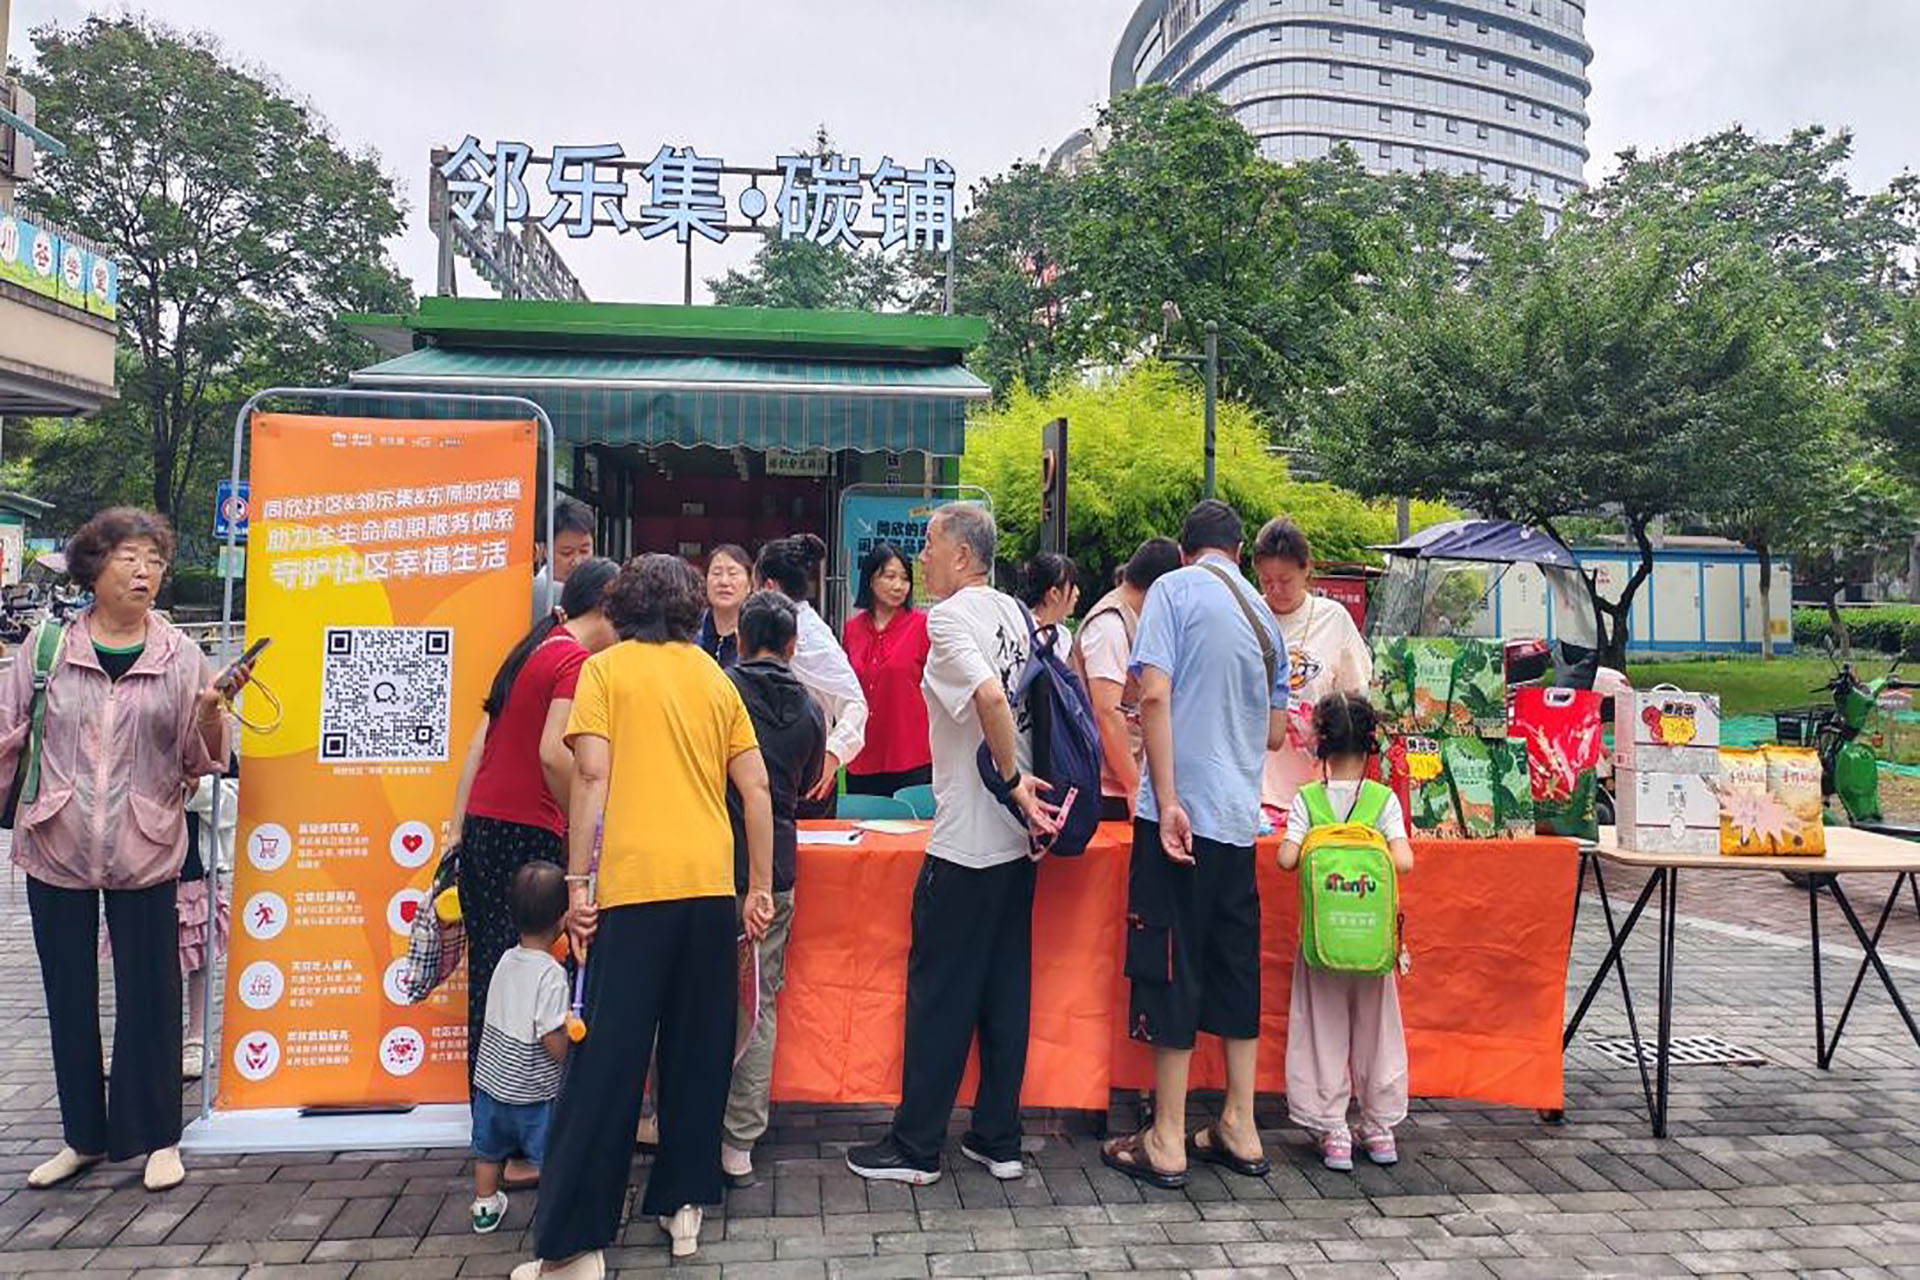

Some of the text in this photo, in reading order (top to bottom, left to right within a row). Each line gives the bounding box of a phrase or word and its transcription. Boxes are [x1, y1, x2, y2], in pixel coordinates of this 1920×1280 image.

[268, 507, 514, 551] 助力全生命周期服务体系
[271, 540, 508, 590] 守护社区幸福生活
